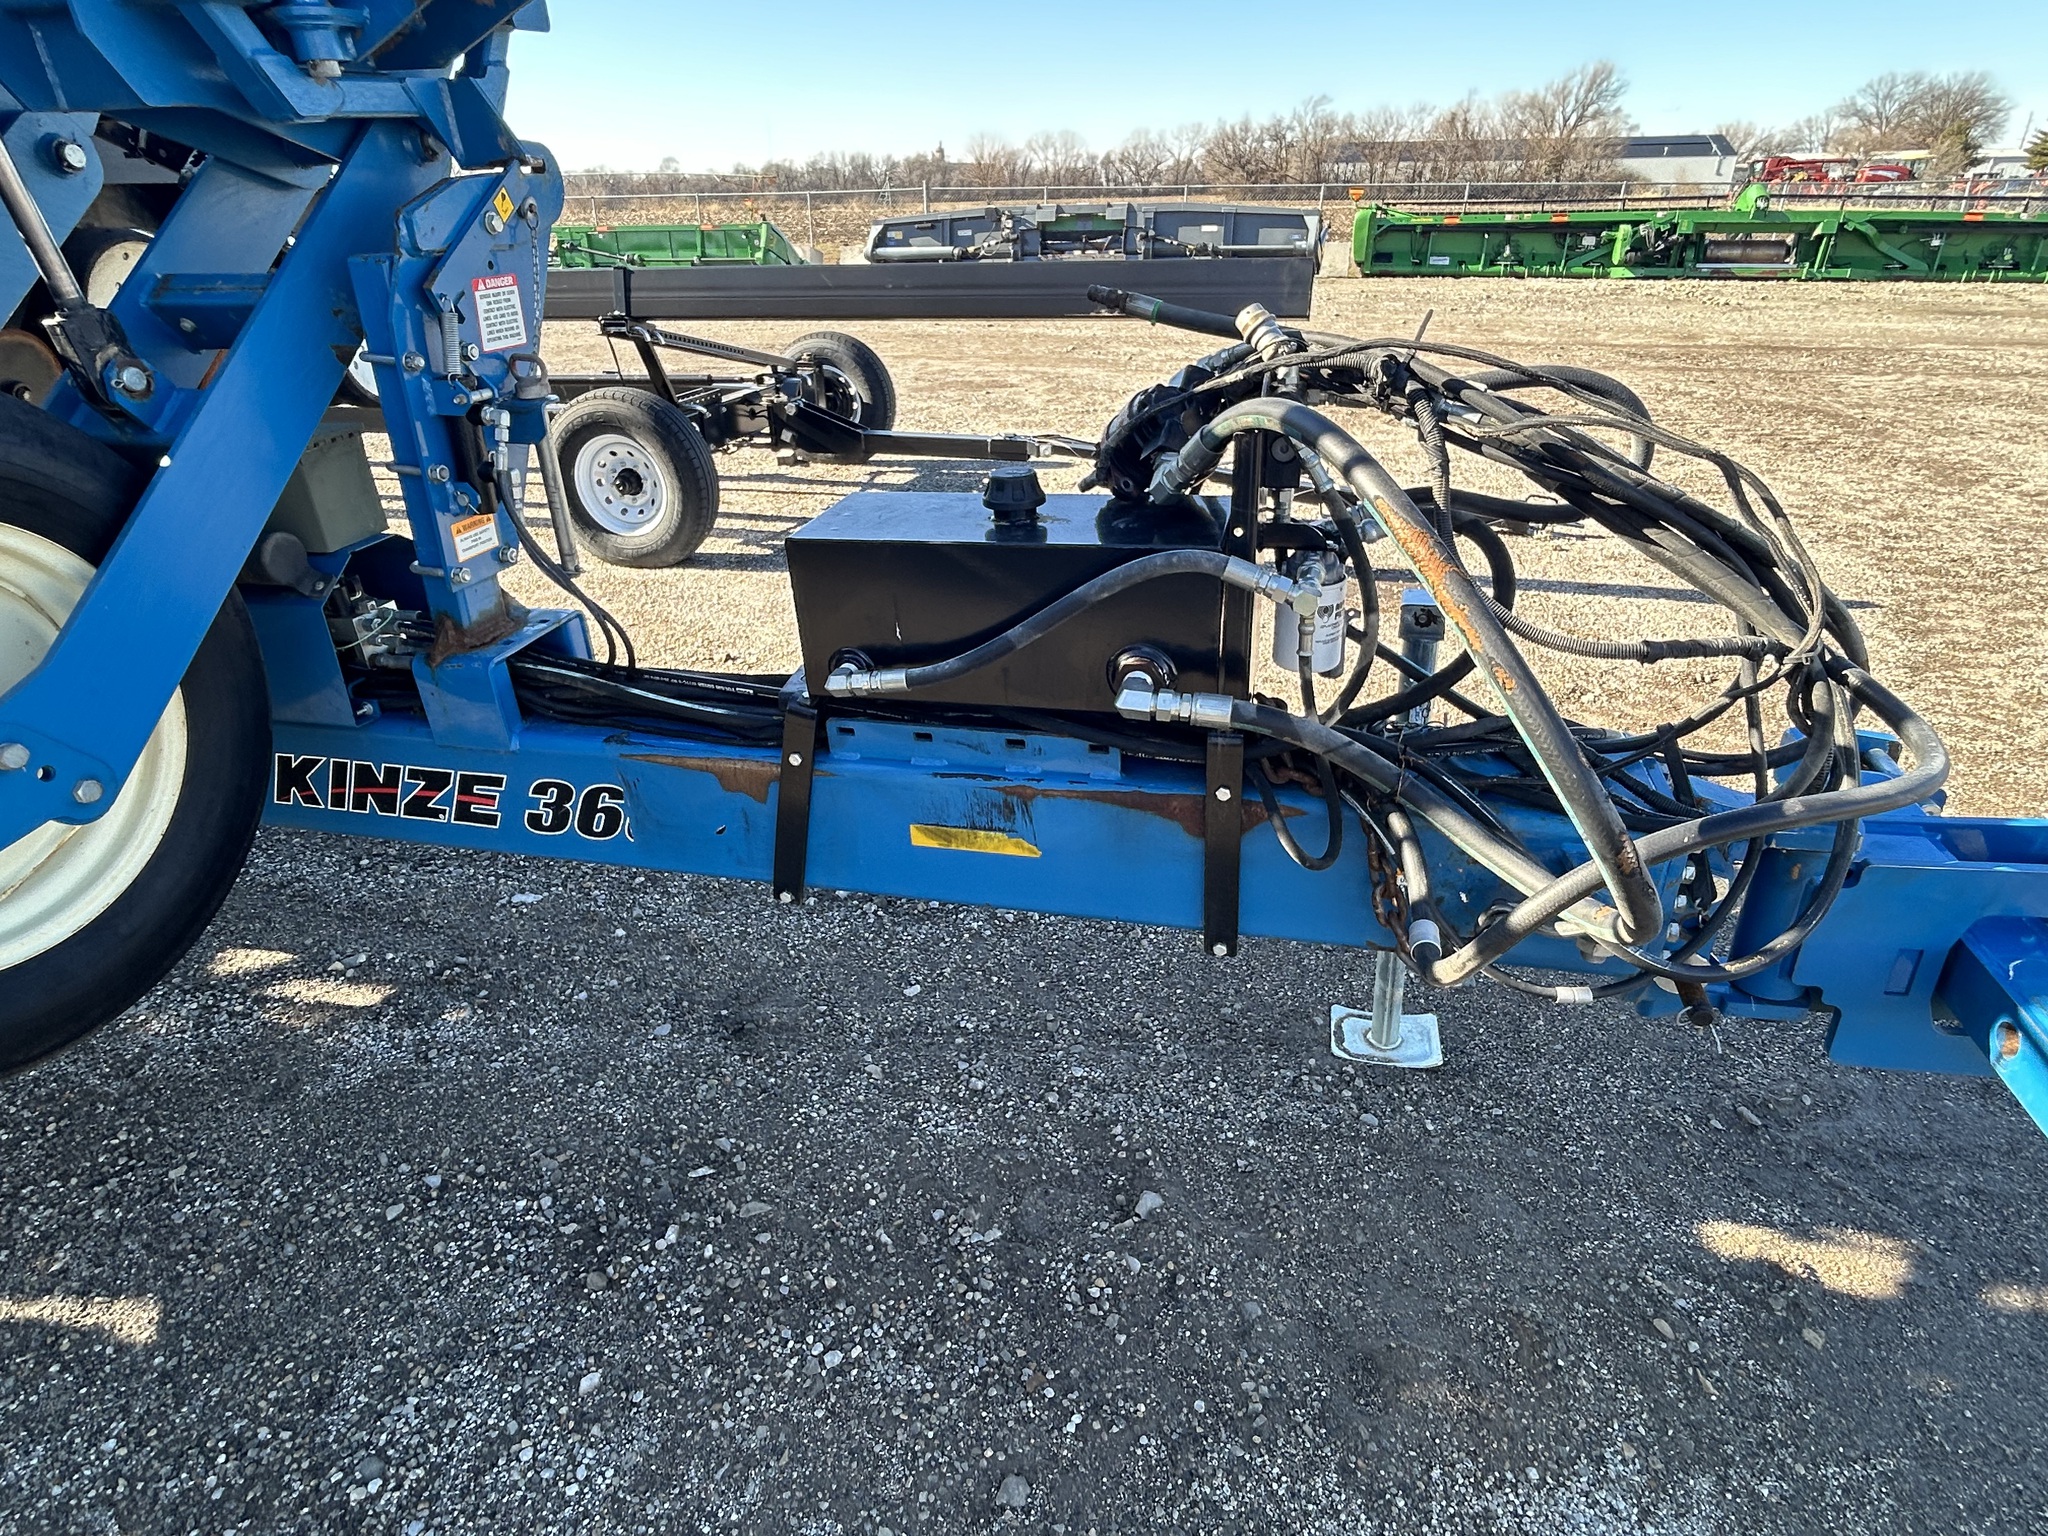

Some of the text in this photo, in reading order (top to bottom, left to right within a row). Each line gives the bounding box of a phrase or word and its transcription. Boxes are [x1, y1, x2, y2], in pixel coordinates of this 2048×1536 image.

[485, 277, 513, 288] DANGER
[462, 517, 485, 531] WARNING
[274, 753, 634, 842] KINZE 36
